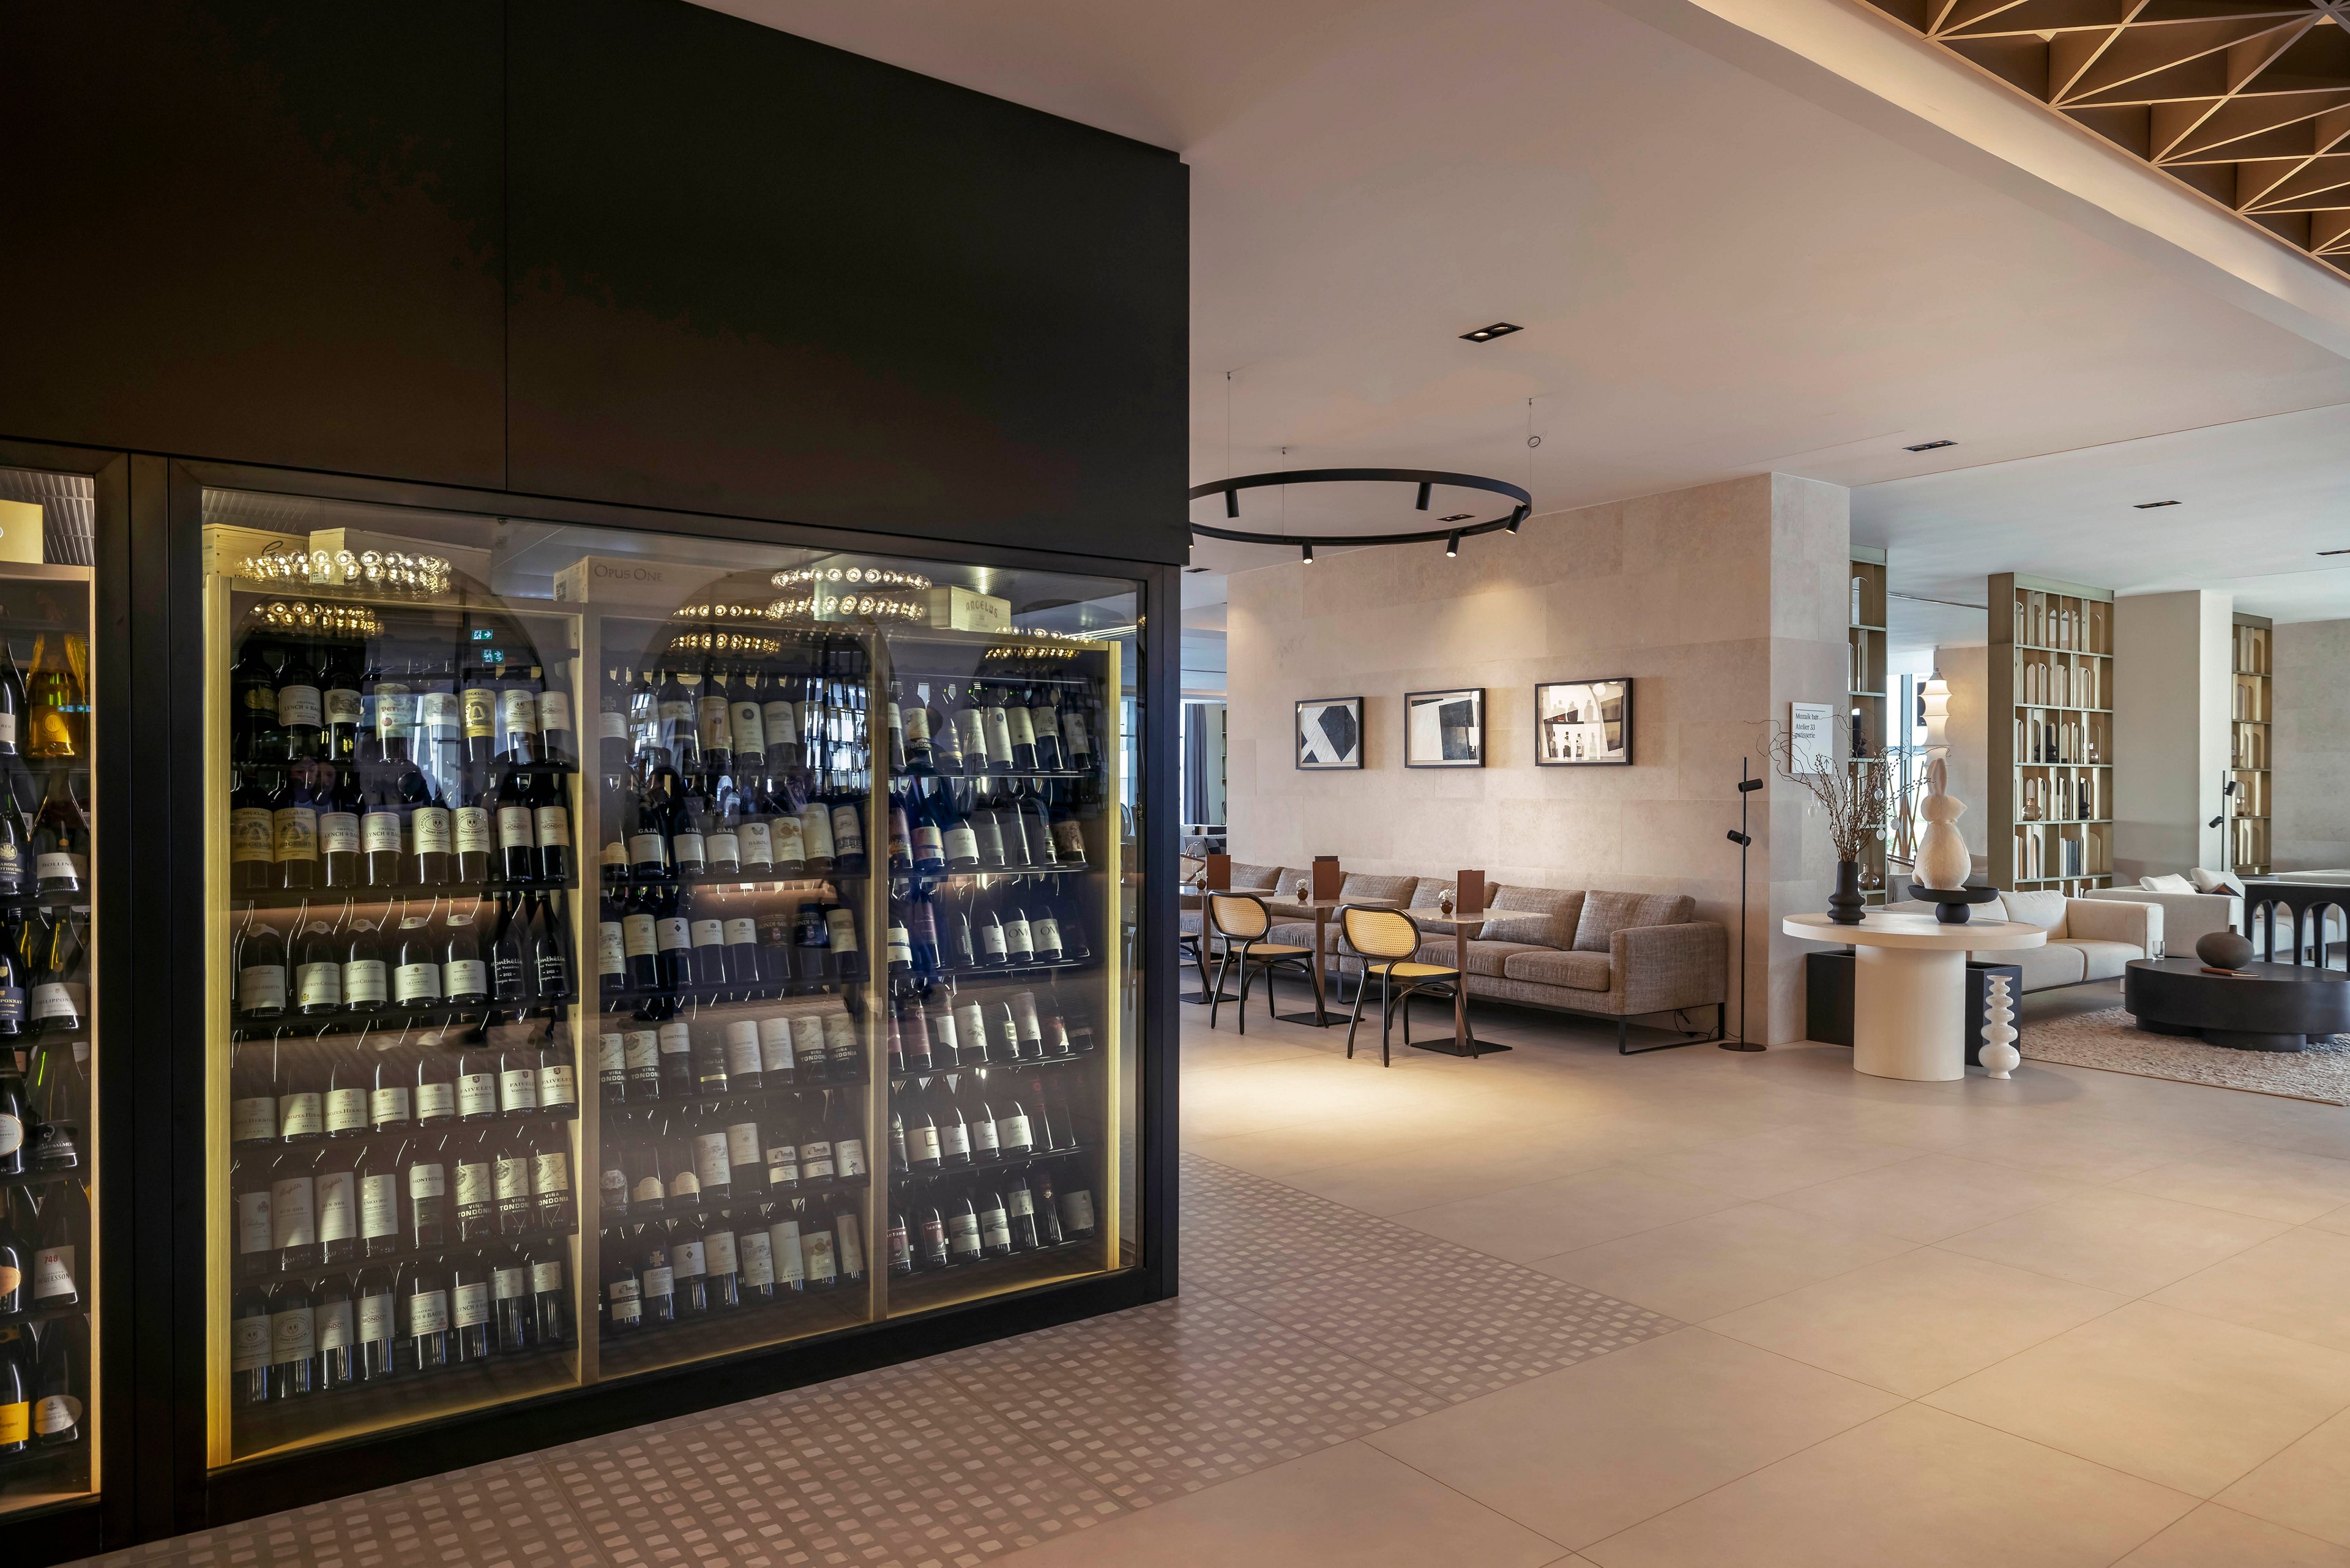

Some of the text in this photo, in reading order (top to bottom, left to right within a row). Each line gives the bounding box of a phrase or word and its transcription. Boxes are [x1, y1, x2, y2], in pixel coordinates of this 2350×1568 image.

[499, 1201, 530, 1212] TONDON
[43, 1255, 59, 1264] 748
[457, 1304, 475, 1313] LYNCH
